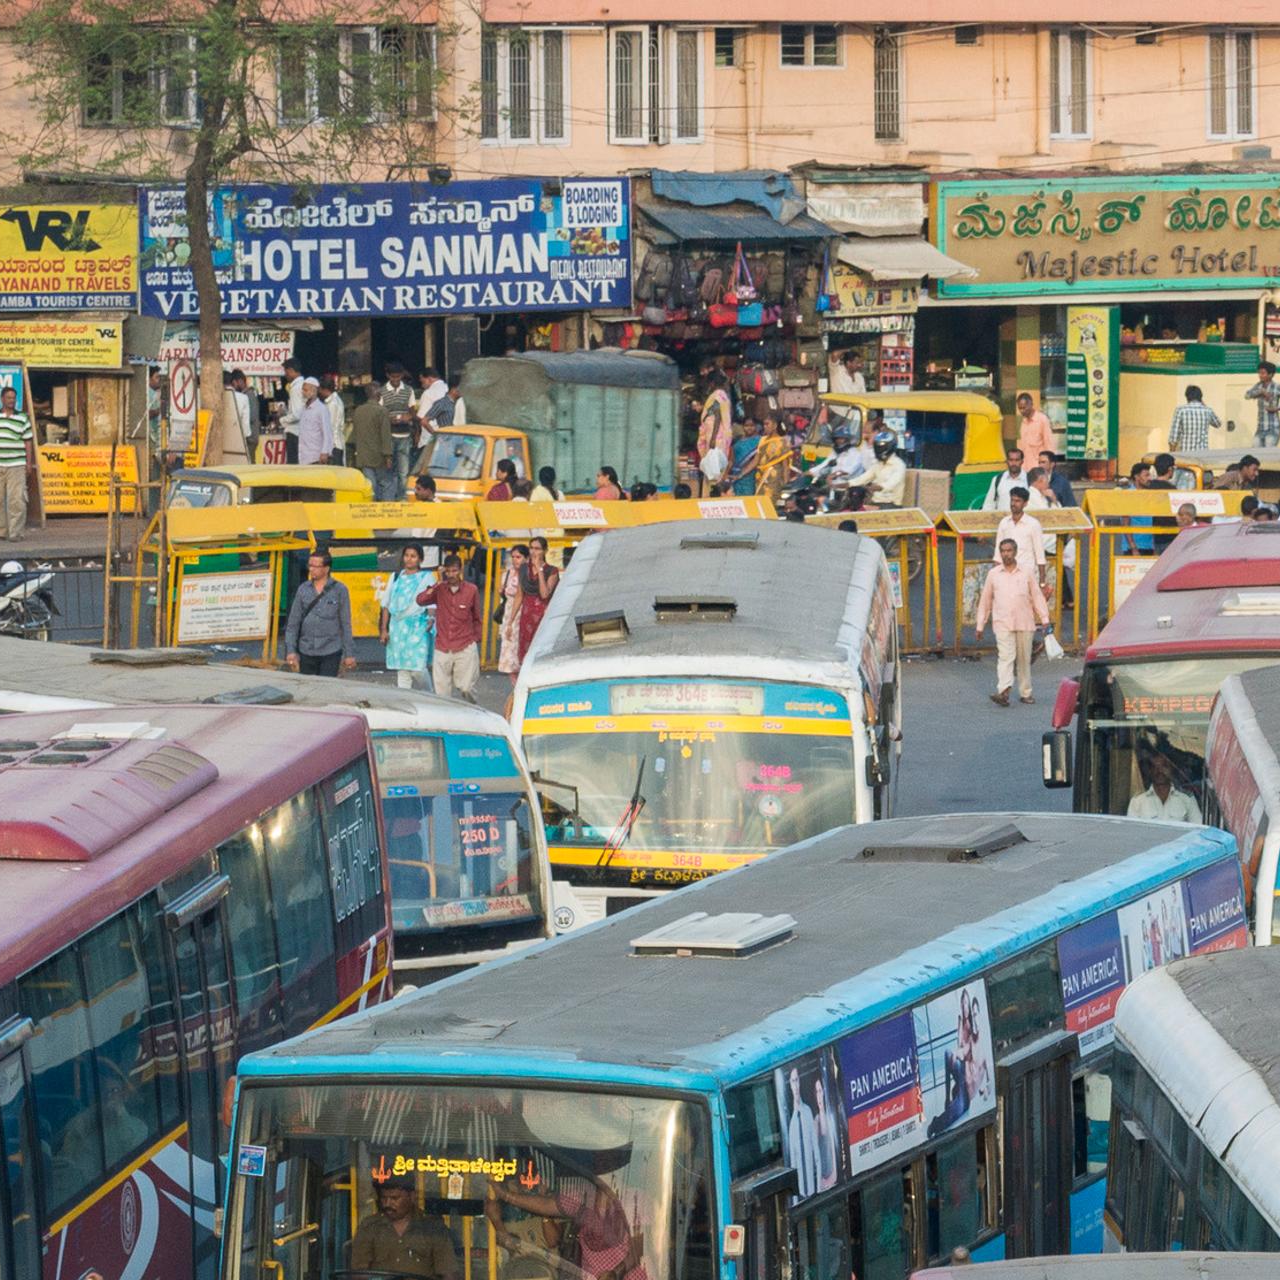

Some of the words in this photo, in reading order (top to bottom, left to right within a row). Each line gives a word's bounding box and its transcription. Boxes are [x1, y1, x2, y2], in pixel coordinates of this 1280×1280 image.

[565, 186, 618, 205] BOARDING
[244, 197, 393, 229] ಹೋಟೆಲ್
[410, 194, 534, 233] ಸನ್ಮಾನ್
[567, 207, 574, 224] &
[577, 204, 617, 225] LODGING
[0, 209, 103, 253] VRL
[234, 237, 367, 282] HOTEL
[381, 232, 548, 280] SANMAN
[1018, 250, 1160, 286] Majestic
[1171, 245, 1258, 275] Hotel
[578, 258, 627, 280] RESTAURANT
[66, 276, 130, 291] TRAVELS
[395, 278, 615, 309] RESTAURANT
[35, 296, 84, 307] TOURIST
[87, 295, 130, 306] CENTRE
[68, 337, 94, 345] CENTRE
[96, 329, 117, 338] VRL
[42, 452, 64, 462] VRL
[556, 507, 577, 519] POLICE
[578, 507, 601, 520] STATION
[758, 764, 791, 779] 364B
[461, 829, 486, 844] 250
[490, 828, 499, 842] D
[672, 853, 703, 868] 364B
[1190, 916, 1208, 937] PAN
[1209, 897, 1242, 927] AMERICA
[1062, 976, 1080, 998] PAN
[1081, 956, 1119, 989] AMERICA
[850, 1074, 870, 1100] PAN
[872, 1056, 912, 1090] AMERICA
[393, 1157, 413, 1177] ಶ್ರೀ
